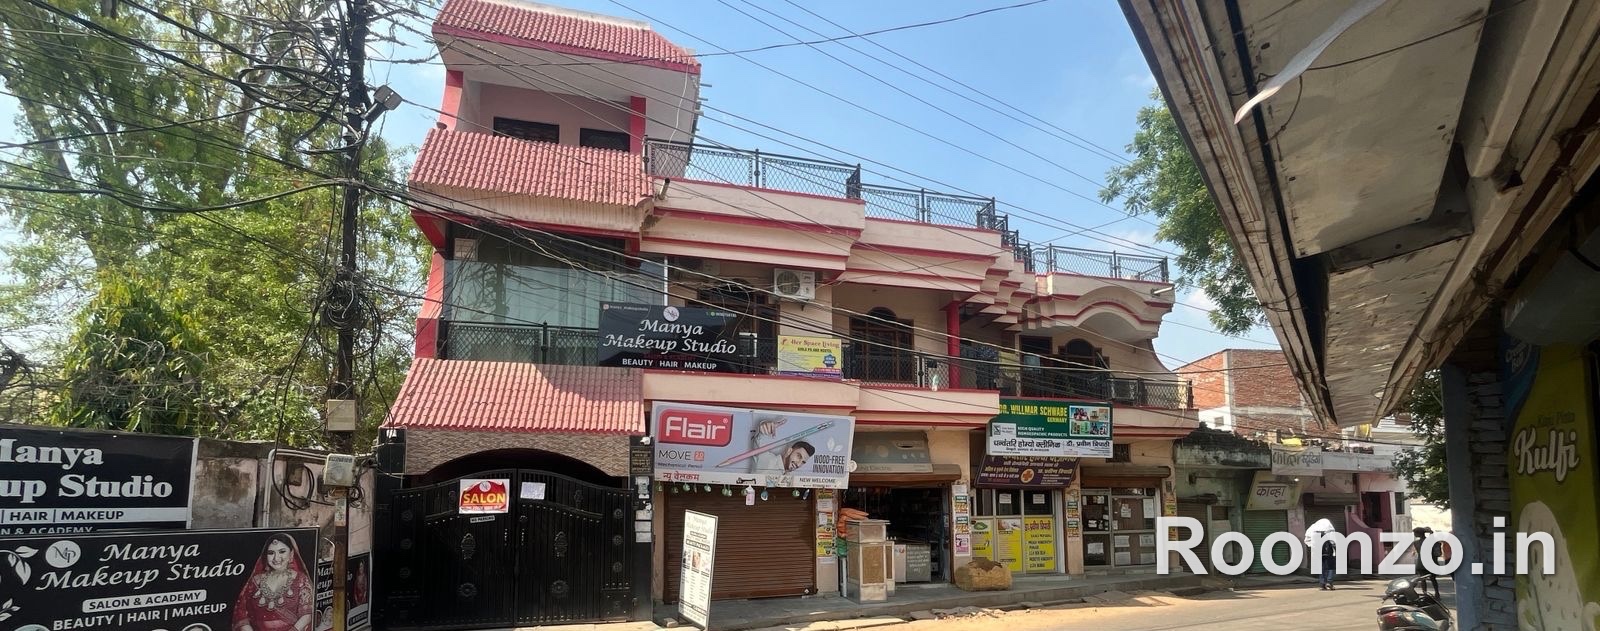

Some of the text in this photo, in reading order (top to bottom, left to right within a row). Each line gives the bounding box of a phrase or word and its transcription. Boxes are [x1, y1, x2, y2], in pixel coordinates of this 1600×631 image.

[638, 319, 704, 339] Manya
[603, 334, 737, 355] Makeup Studio
[622, 358, 717, 370] BEAUTY HAIR MAKEUP
[1010, 404, 1038, 415] WILLMAR
[1039, 406, 1068, 417] SCHWABE
[665, 416, 726, 440] Flair
[658, 450, 691, 460] MOVE
[814, 455, 845, 465] WOOD-FREE
[1513, 426, 1580, 482] Kulfi
[673, 471, 700, 481] वेलकम
[812, 464, 845, 474] INNOVATION
[58, 474, 173, 498] Studio
[463, 493, 506, 504] SALON
[9, 510, 124, 521] HAIR MAKEUP
[99, 543, 201, 565] Manya
[35, 558, 246, 591] Makeup Studio
[88, 592, 201, 611] SALON & ACADEMY
[53, 603, 228, 631] BEAUTY HAIR MAKEUP
